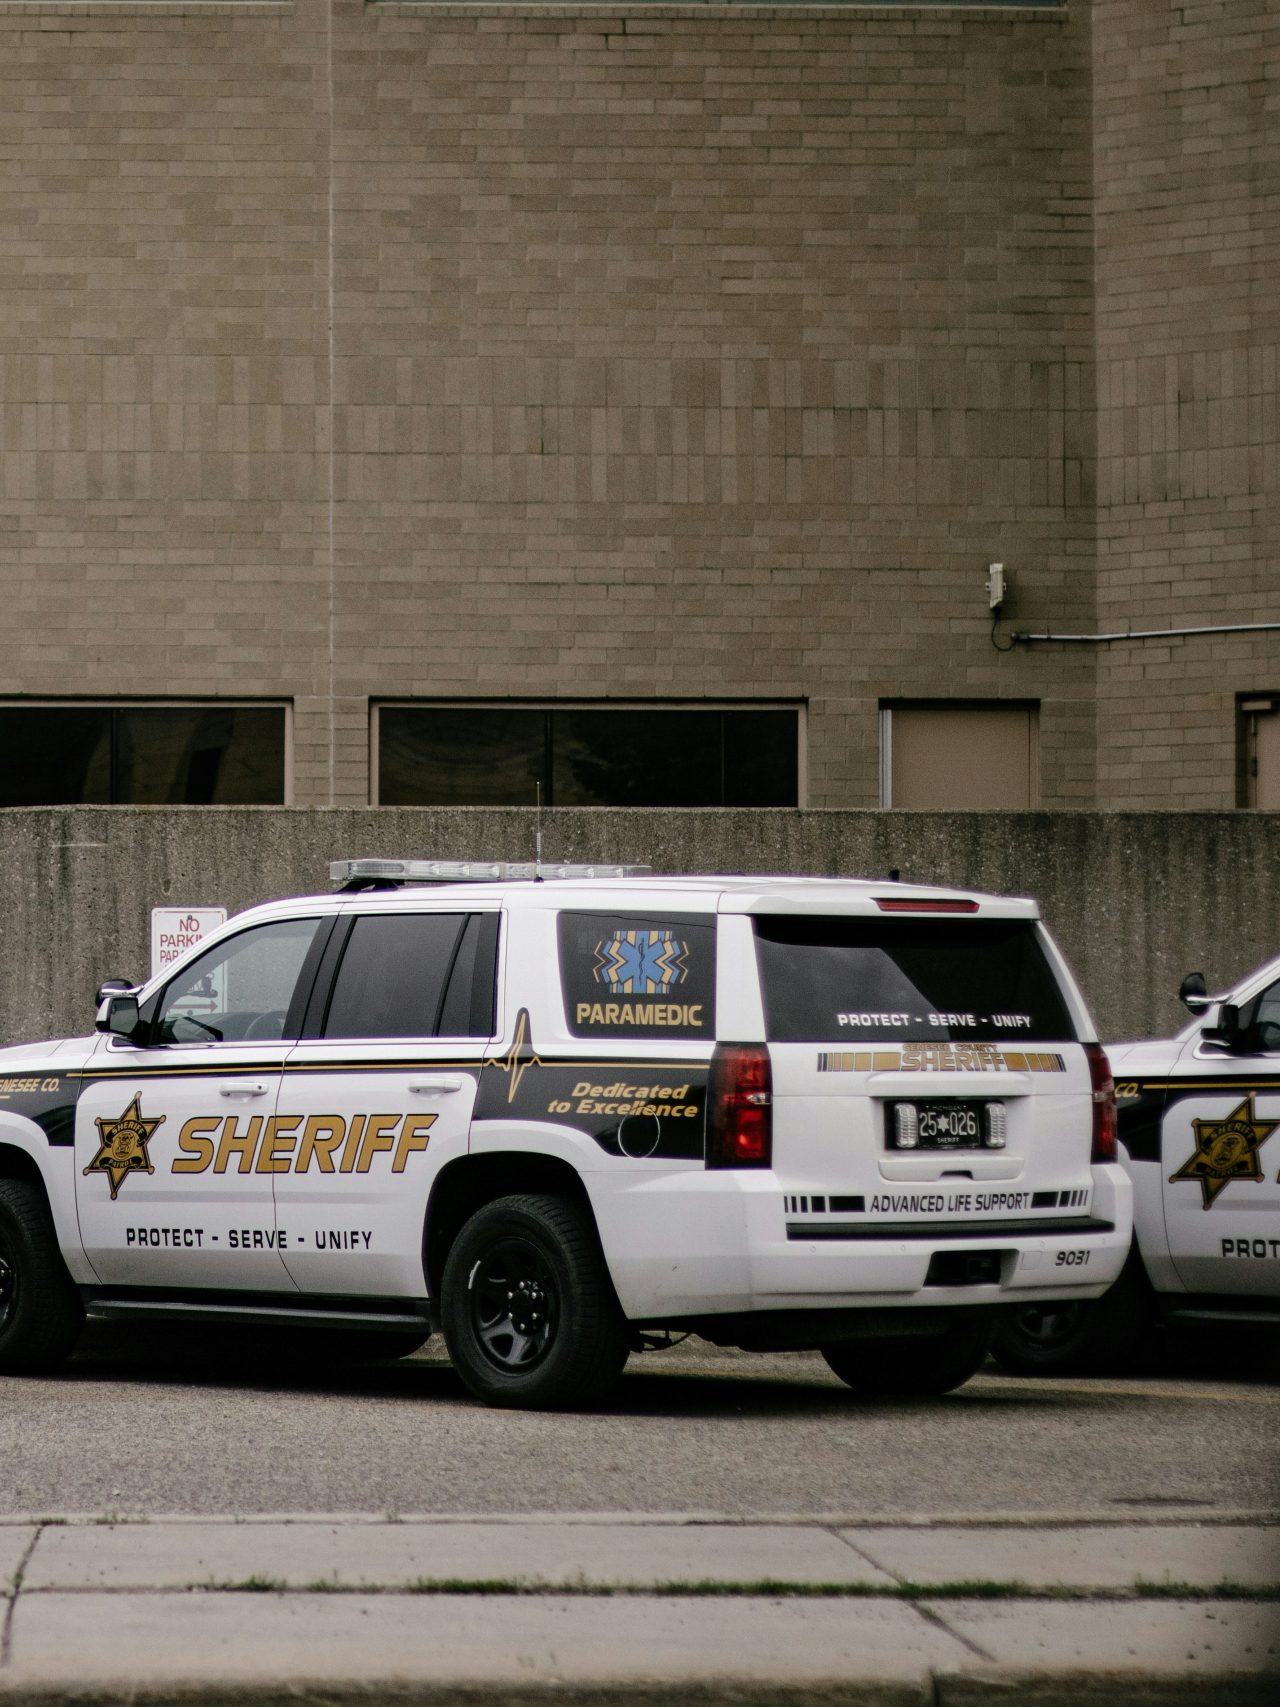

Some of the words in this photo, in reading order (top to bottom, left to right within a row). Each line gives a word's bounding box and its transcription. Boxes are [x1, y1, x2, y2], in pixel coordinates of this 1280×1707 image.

[180, 918, 200, 932] NO
[160, 934, 203, 947] PARK
[576, 1003, 703, 1026] PARAMEDIC
[837, 1014, 910, 1027] PROTECT
[928, 1014, 977, 1027] SERVE
[992, 1015, 1032, 1028] UNIFY
[902, 1043, 951, 1051] GENESEE
[954, 1043, 998, 1052] COUNTY
[900, 1051, 1007, 1071] SHERIFF
[40, 1078, 60, 1092] CO.
[571, 1082, 689, 1100] Dedicated
[1114, 1082, 1139, 1098] CO.
[547, 1099, 571, 1114] to
[576, 1099, 699, 1118] Excellence
[111, 1121, 145, 1136] SHERIFF
[920, 1112, 937, 1136] 25
[949, 1112, 976, 1135] 026
[170, 1114, 440, 1174] SHERIFF
[871, 1195, 944, 1212] ADVANCED
[948, 1195, 972, 1211] LIFE
[975, 1192, 1030, 1211] SUPPORT
[126, 1228, 204, 1247] PROTECT
[228, 1230, 288, 1249] SERVE
[315, 1230, 372, 1250] UNIFY
[1055, 1250, 1091, 1266] 9031
